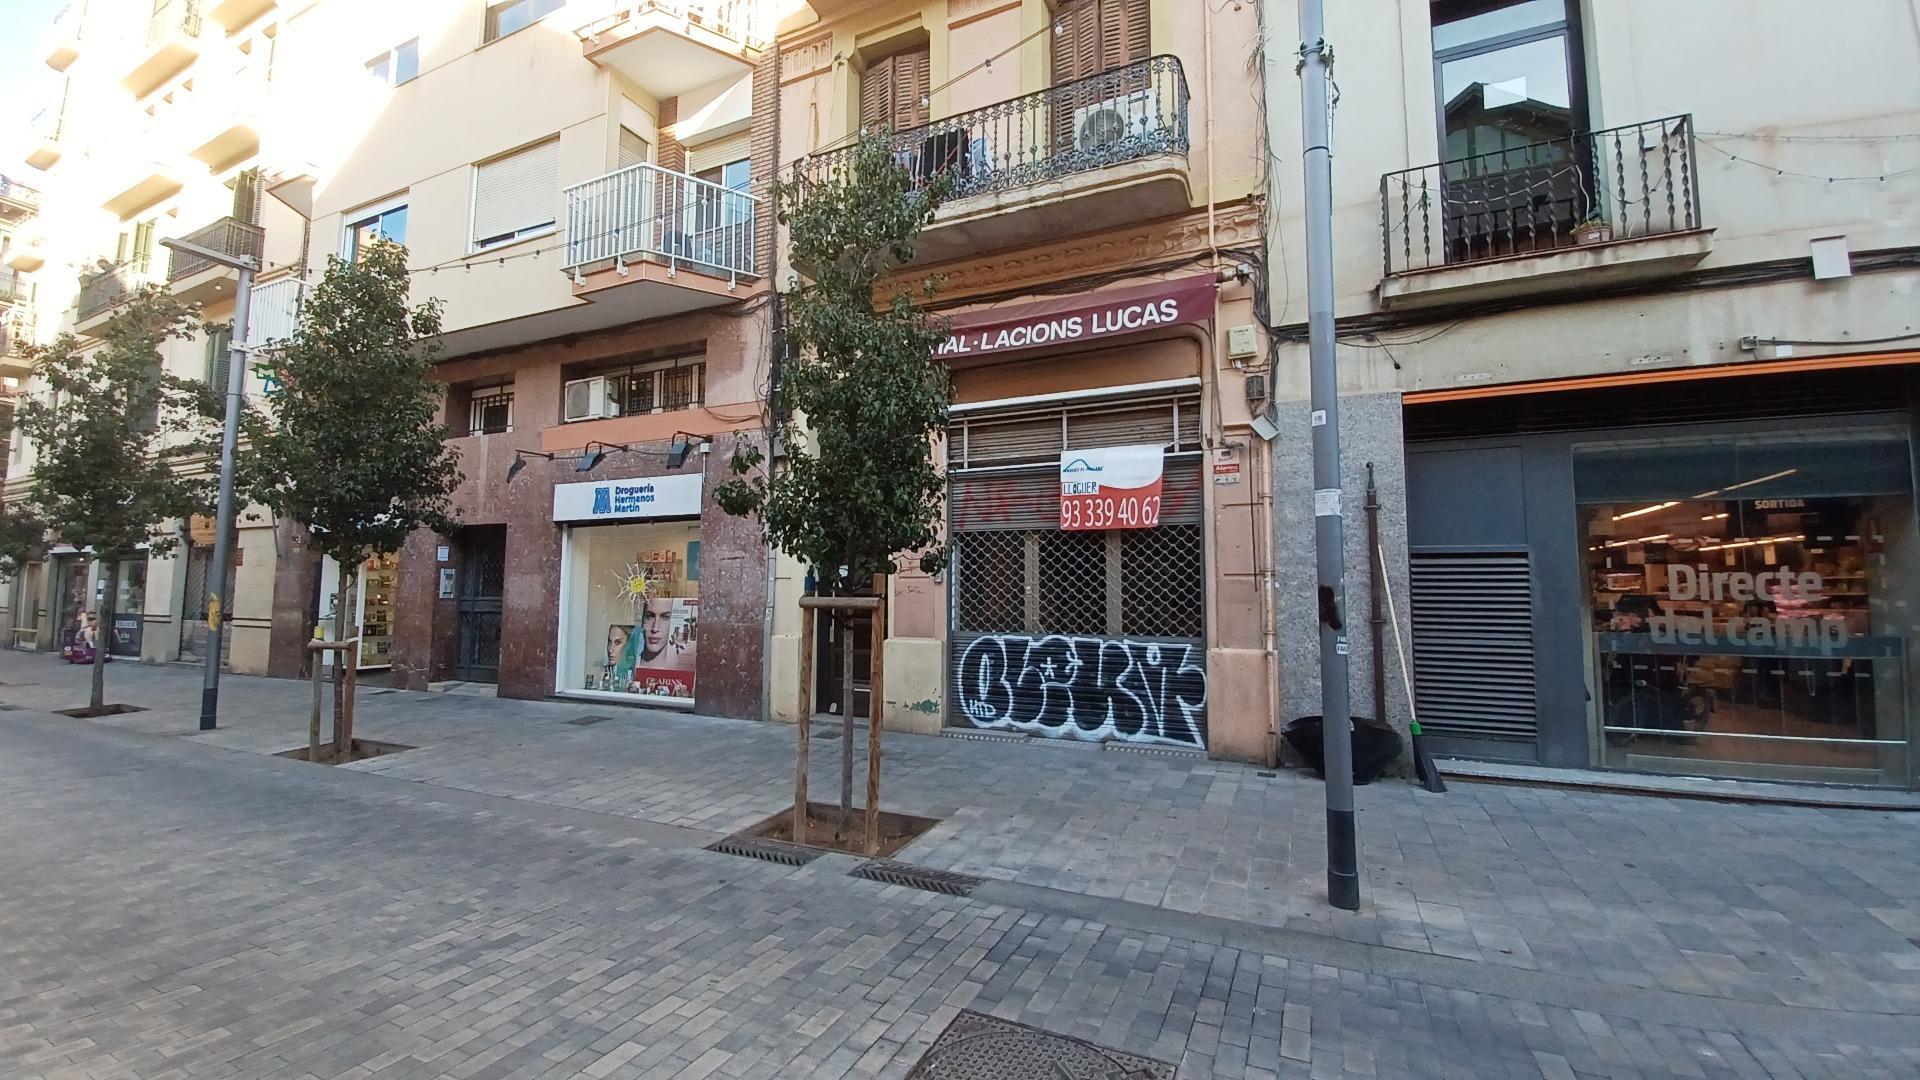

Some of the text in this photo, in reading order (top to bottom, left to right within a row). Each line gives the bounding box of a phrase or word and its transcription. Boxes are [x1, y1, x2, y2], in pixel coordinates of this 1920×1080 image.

[1091, 298, 1179, 334] LUCAS
[614, 494, 655, 504] Hermanos
[615, 483, 655, 496] Droguería
[1063, 481, 1098, 495] LLOGUER
[1062, 500, 1081, 528] 93
[1085, 498, 1114, 526] 339
[1118, 497, 1139, 526] 40
[1142, 495, 1160, 525] 62
[1754, 499, 1805, 510] SORTIDA
[1667, 563, 1823, 602] Directe
[1650, 606, 1849, 656] del camp
